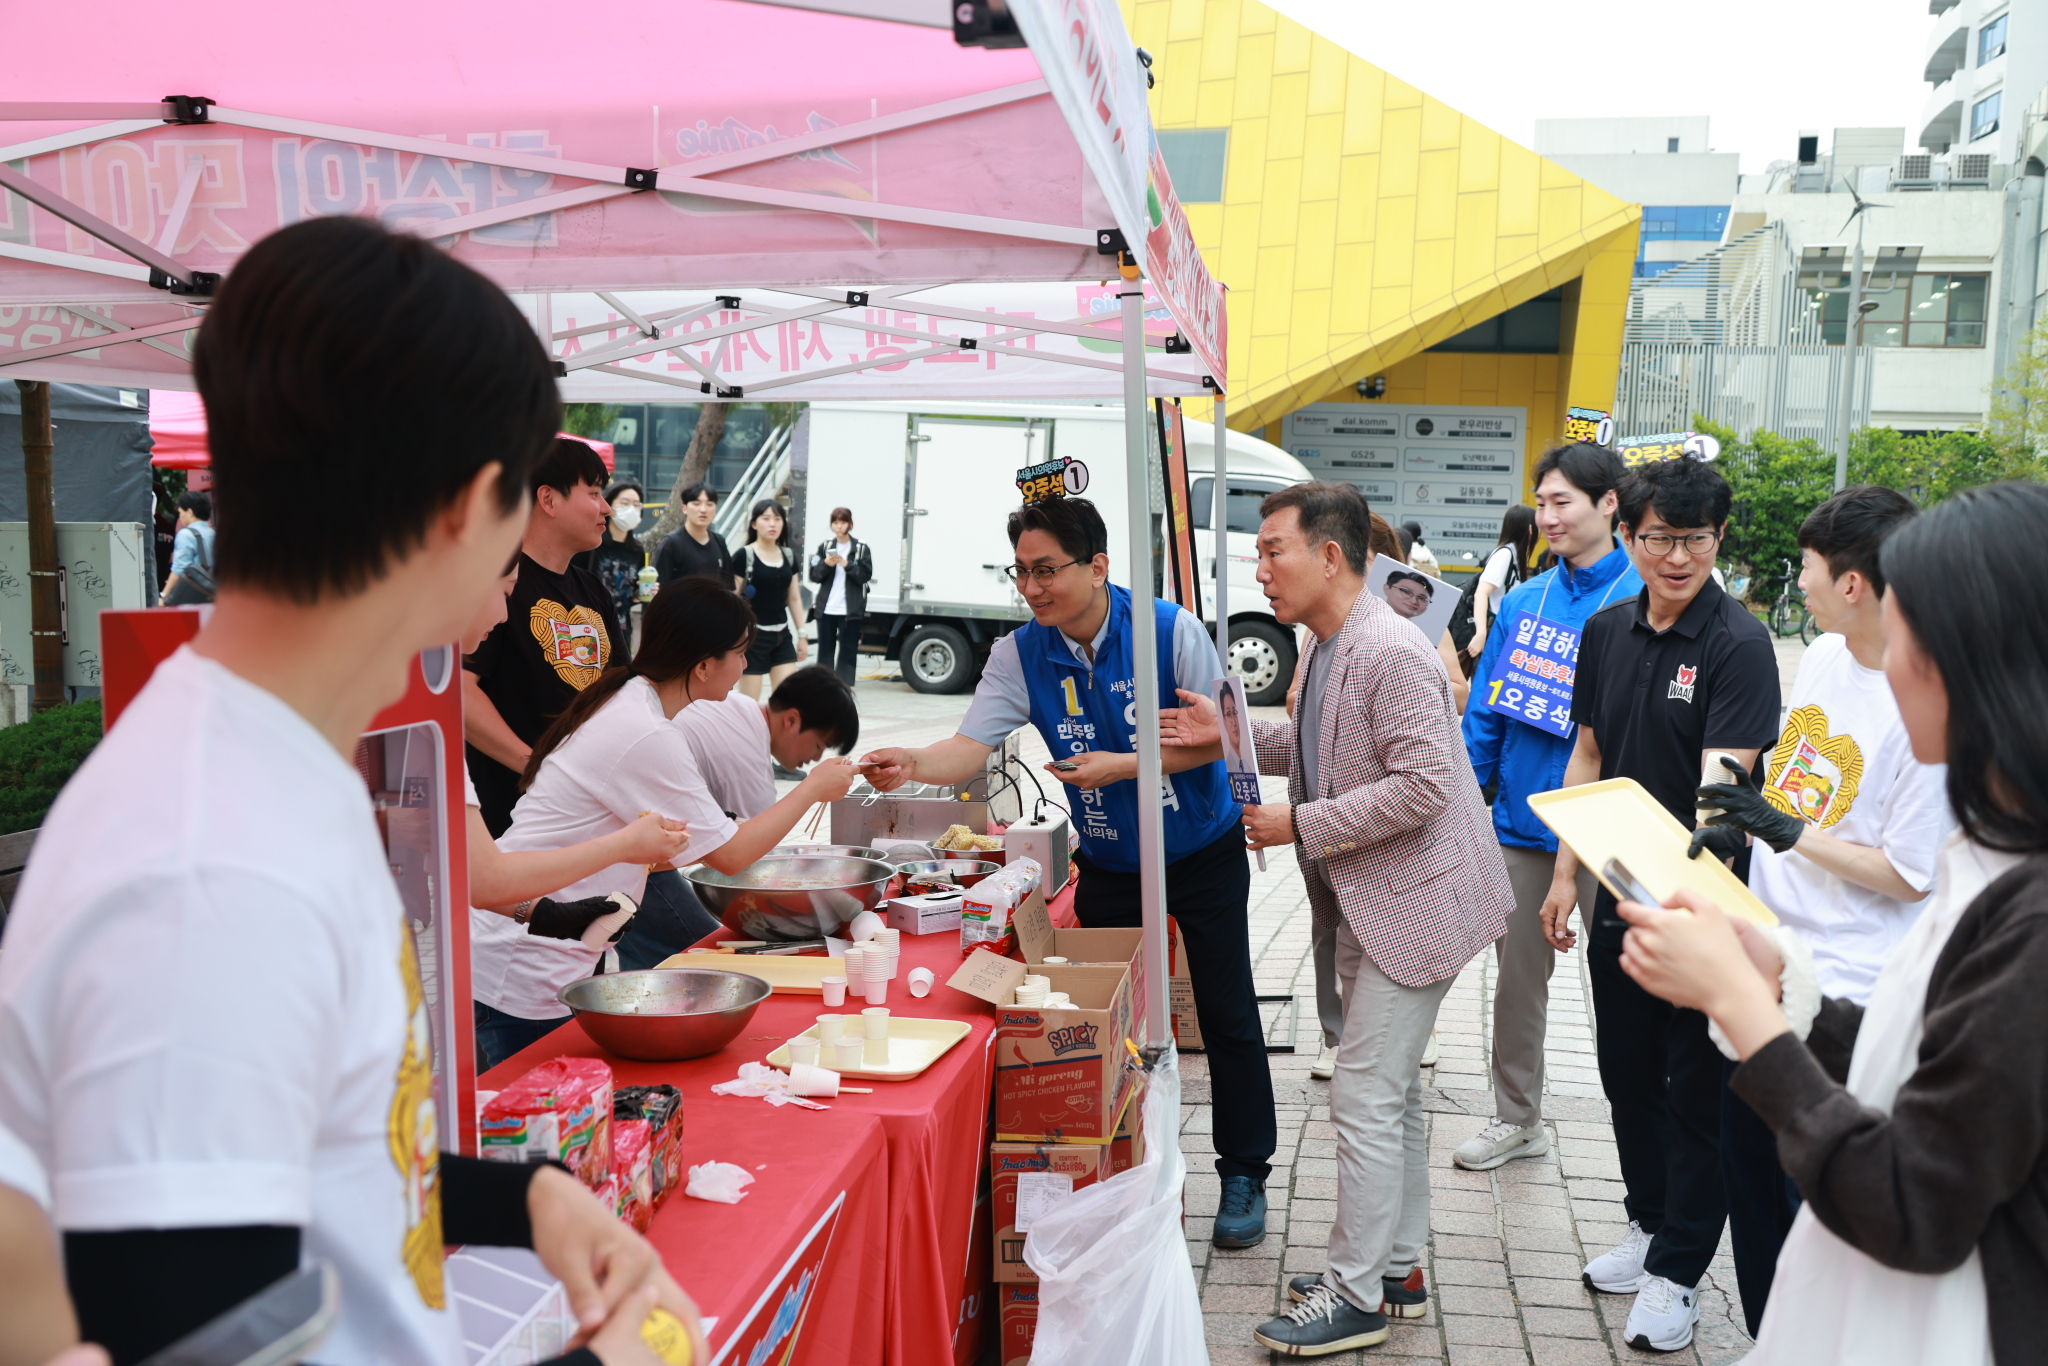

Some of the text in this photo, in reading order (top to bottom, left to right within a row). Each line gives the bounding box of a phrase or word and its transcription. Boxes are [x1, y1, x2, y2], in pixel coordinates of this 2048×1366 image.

[1341, 417, 1388, 426] dal.komm
[1459, 419, 1502, 430] 본우리반상
[1298, 449, 1320, 457] GS25
[1351, 450, 1375, 459] GS25
[1070, 466, 1080, 490] 1
[1430, 548, 1479, 558] ORMATIN
[1061, 675, 1084, 716] 1
[1487, 679, 1504, 706] 1
[1499, 687, 1571, 731] 오중석
[1057, 723, 1096, 740] 민주당
[1235, 781, 1259, 802] 오중석
[1083, 825, 1119, 841] 시의원
[998, 1013, 1040, 1027] Indomie
[1047, 1022, 1098, 1050] SPICY
[1038, 1070, 1083, 1086] goreng
[1003, 1080, 1096, 1100] HOT SPICY CHICKEN FLAVOUR
[1004, 1288, 1039, 1304] Indo
